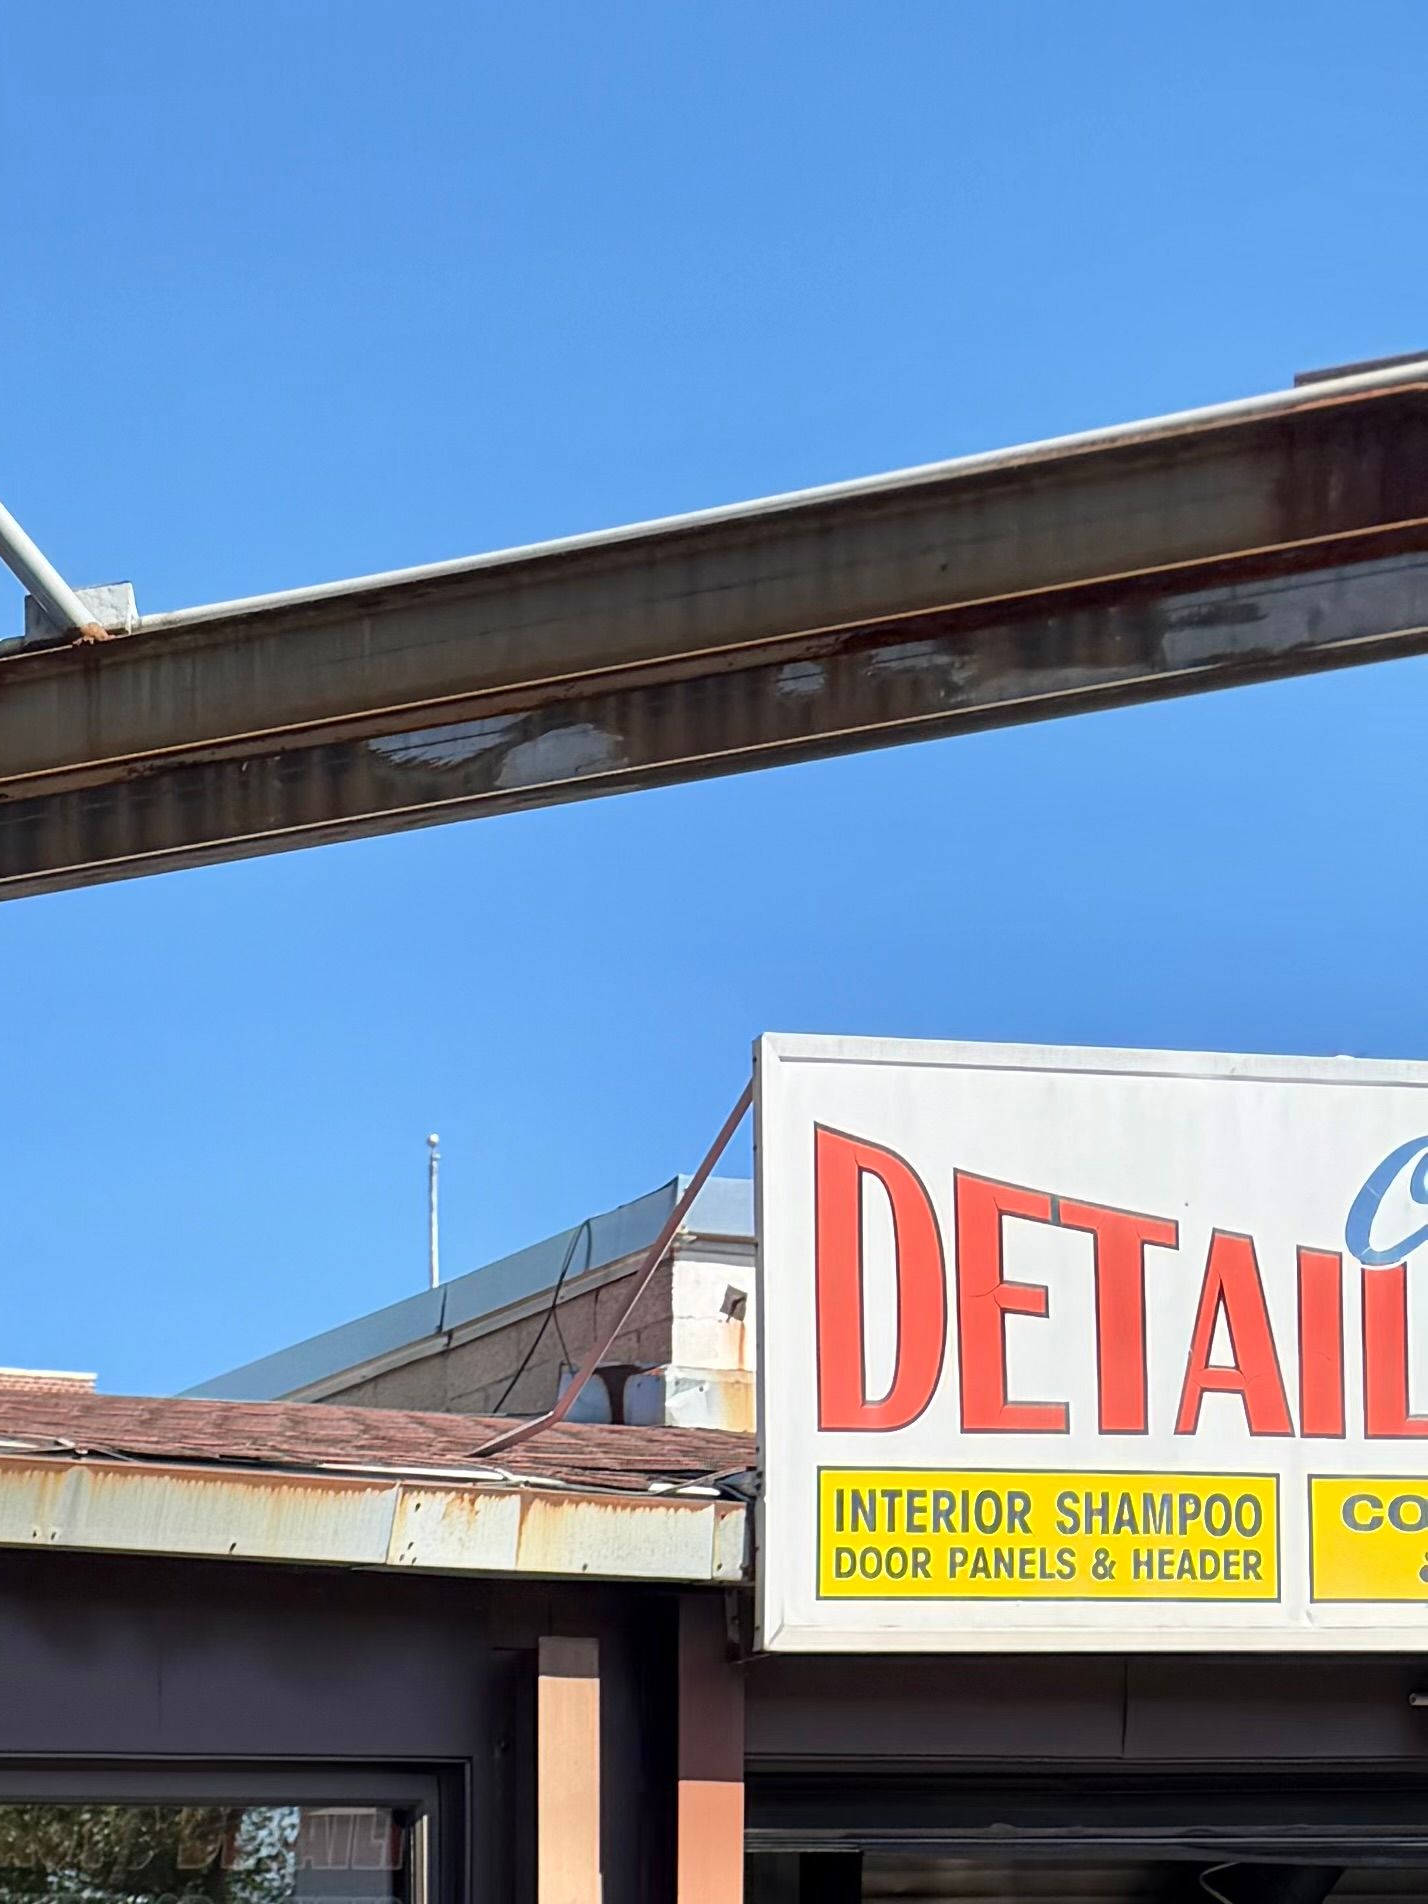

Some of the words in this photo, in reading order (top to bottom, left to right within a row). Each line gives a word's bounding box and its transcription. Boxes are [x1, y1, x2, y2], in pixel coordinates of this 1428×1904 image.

[834, 1488, 1033, 1535] INTERIOR
[1055, 1490, 1263, 1538] SHAMPOO
[834, 1546, 932, 1579] DOOR
[948, 1546, 1076, 1580] PANELS
[1091, 1547, 1116, 1580] &
[1132, 1548, 1263, 1581] HEADER
